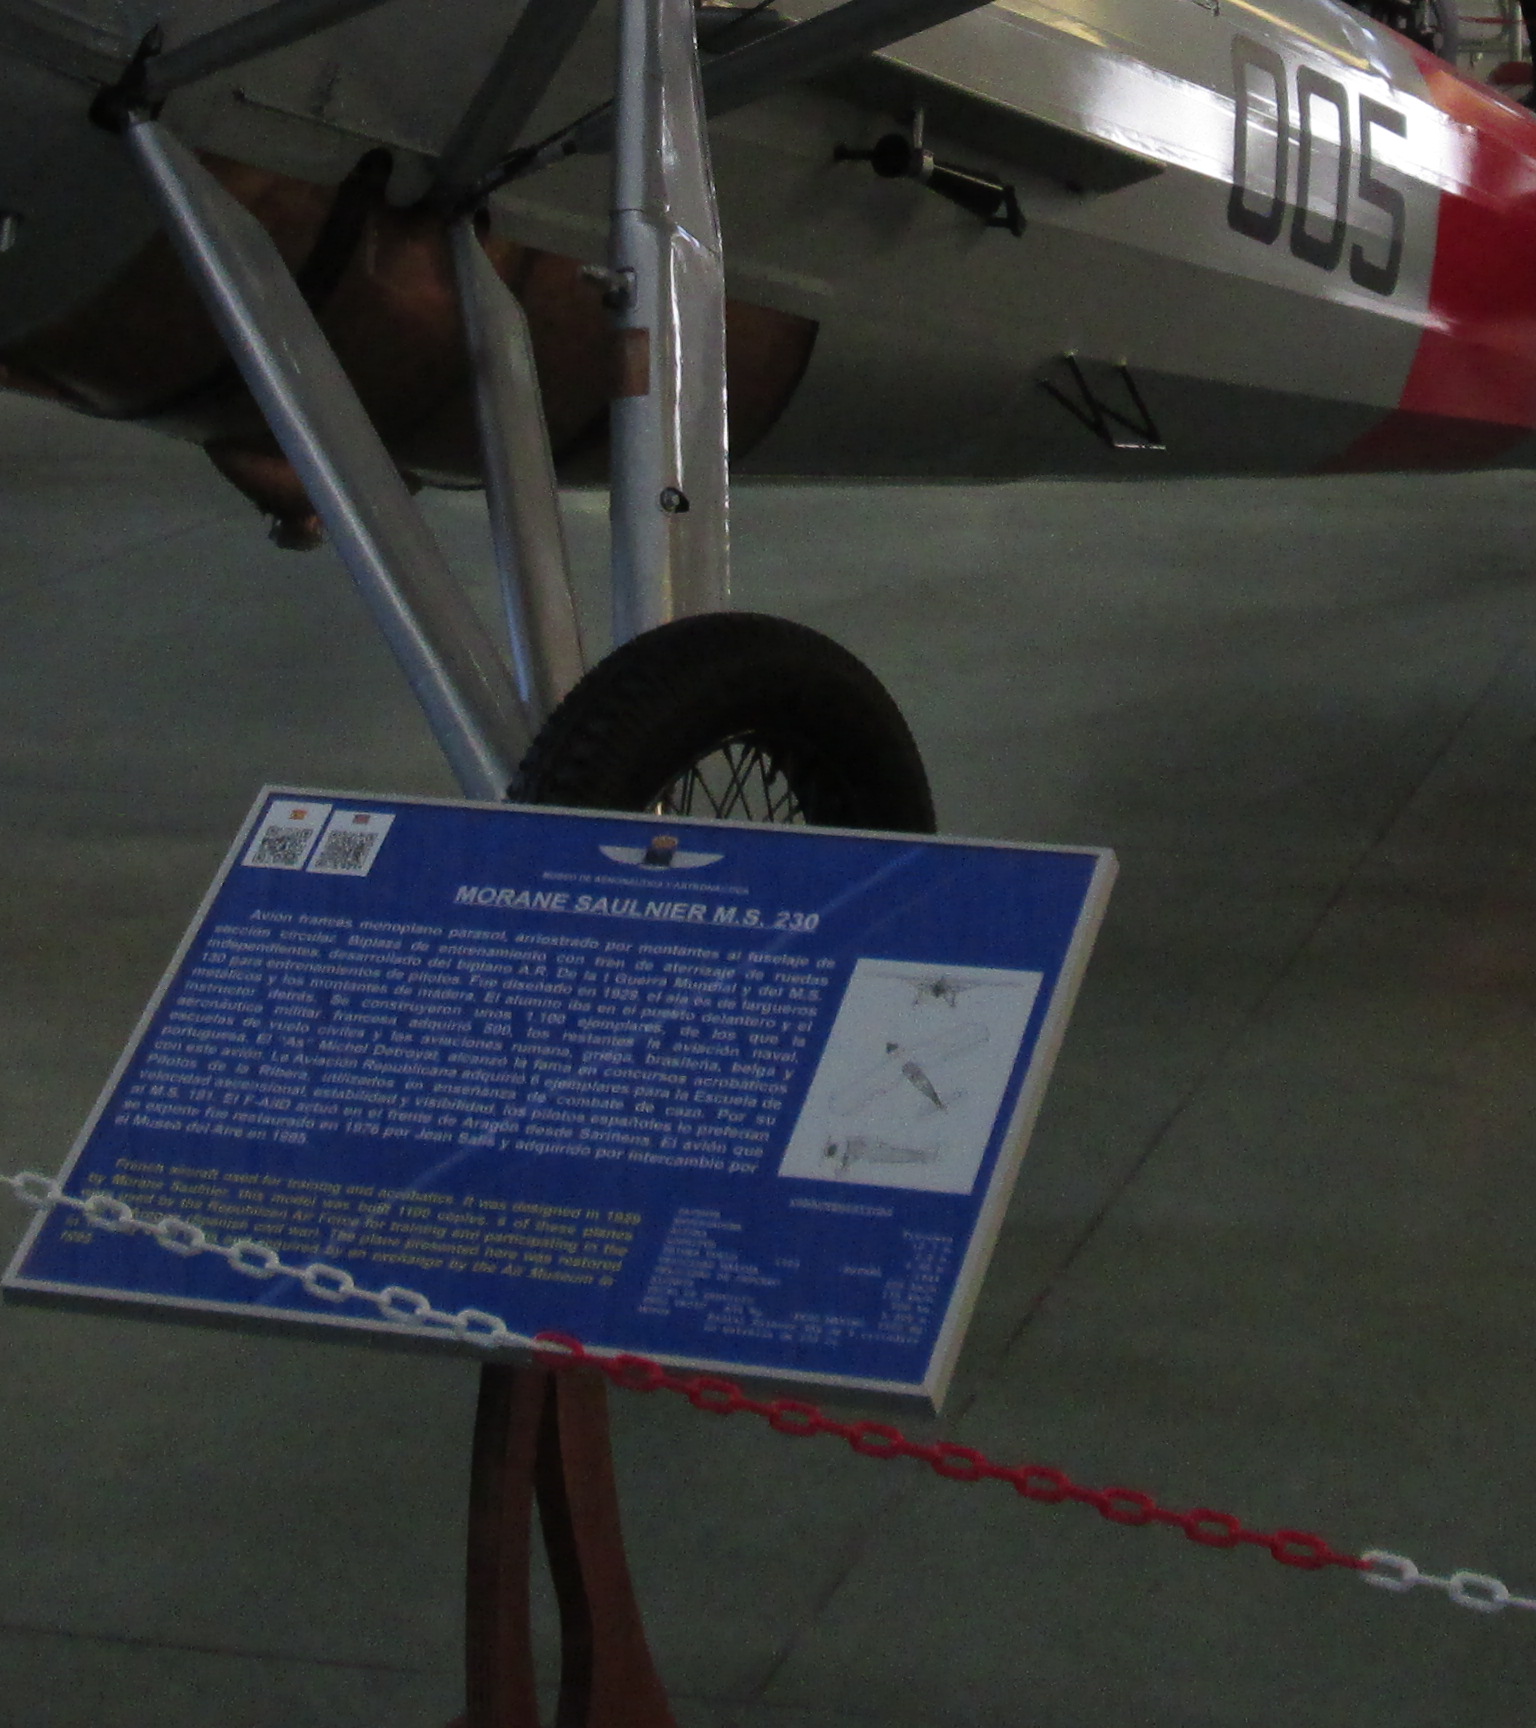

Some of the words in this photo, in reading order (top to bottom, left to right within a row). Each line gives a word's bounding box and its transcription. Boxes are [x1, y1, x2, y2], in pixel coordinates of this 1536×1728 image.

[1227, 31, 1407, 296] 005
[456, 886, 569, 909] MORANE
[575, 895, 706, 920] SAULNIER
[714, 906, 769, 925] M.S.
[775, 911, 821, 929] 230
